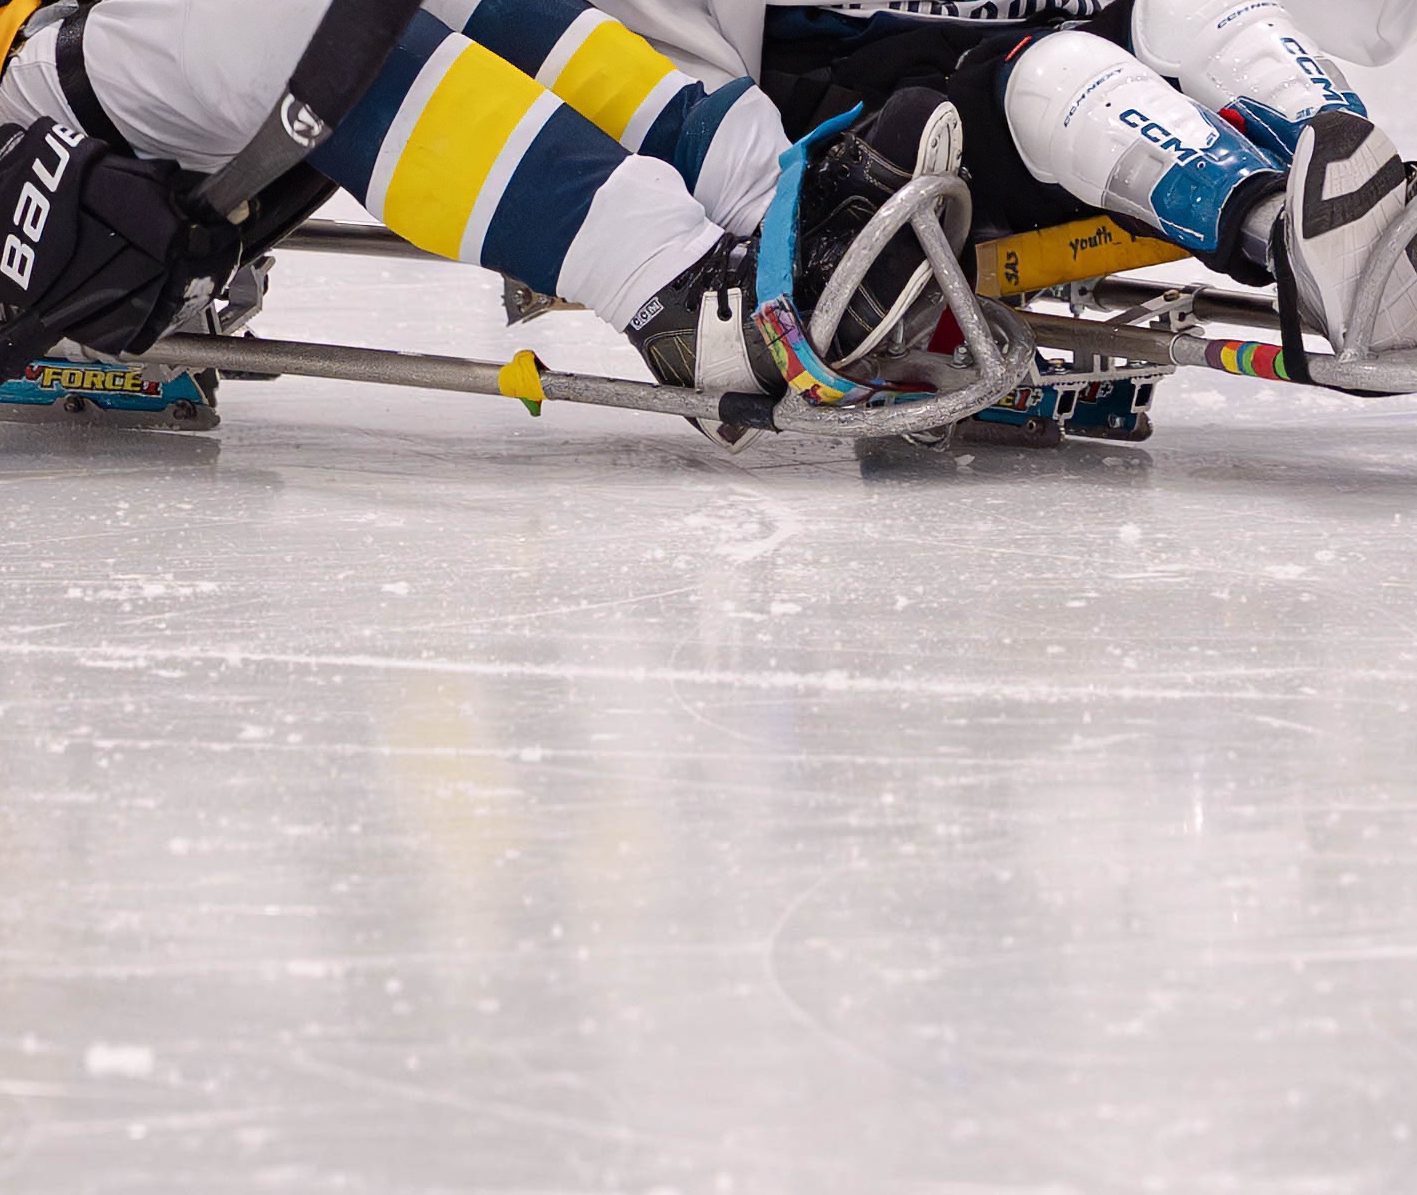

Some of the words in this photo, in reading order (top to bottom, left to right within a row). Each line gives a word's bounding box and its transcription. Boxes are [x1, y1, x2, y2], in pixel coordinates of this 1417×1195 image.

[1279, 37, 1344, 102] CCM
[1119, 108, 1199, 162] CCM
[41, 366, 144, 393] FORCE
